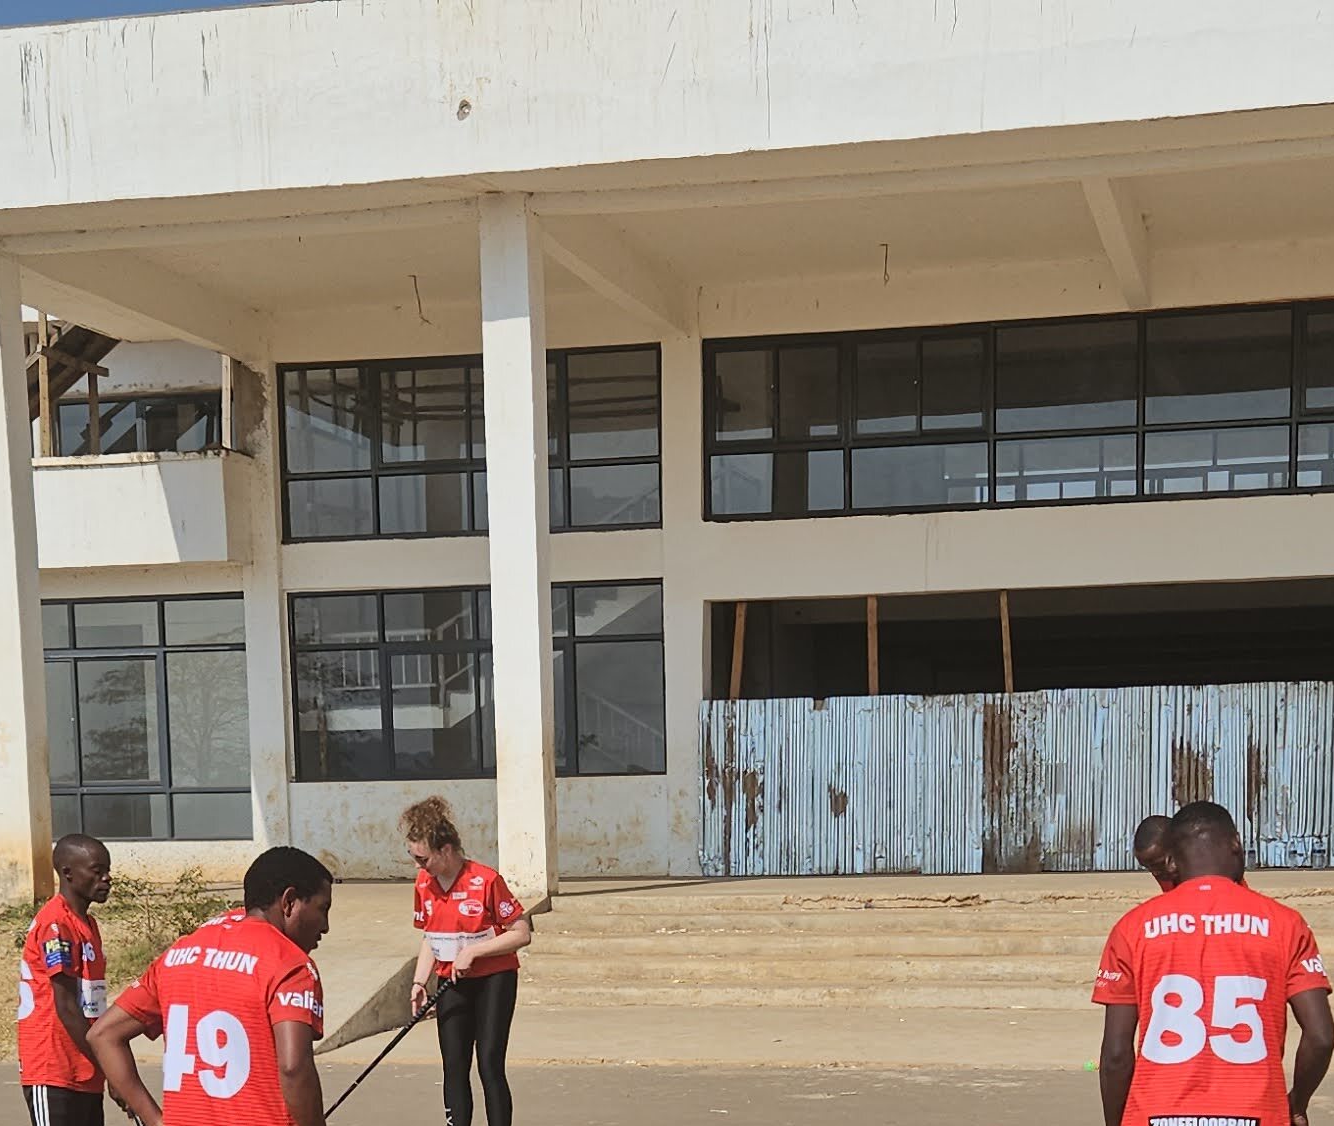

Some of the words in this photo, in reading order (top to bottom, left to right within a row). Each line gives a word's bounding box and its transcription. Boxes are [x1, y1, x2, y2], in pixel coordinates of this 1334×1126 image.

[1144, 912, 1196, 939] UHC
[1200, 913, 1269, 937] THUN
[164, 945, 201, 968] UHC
[203, 948, 259, 975] THUN
[1141, 974, 1267, 1065] 85
[164, 1004, 251, 1099] 49
